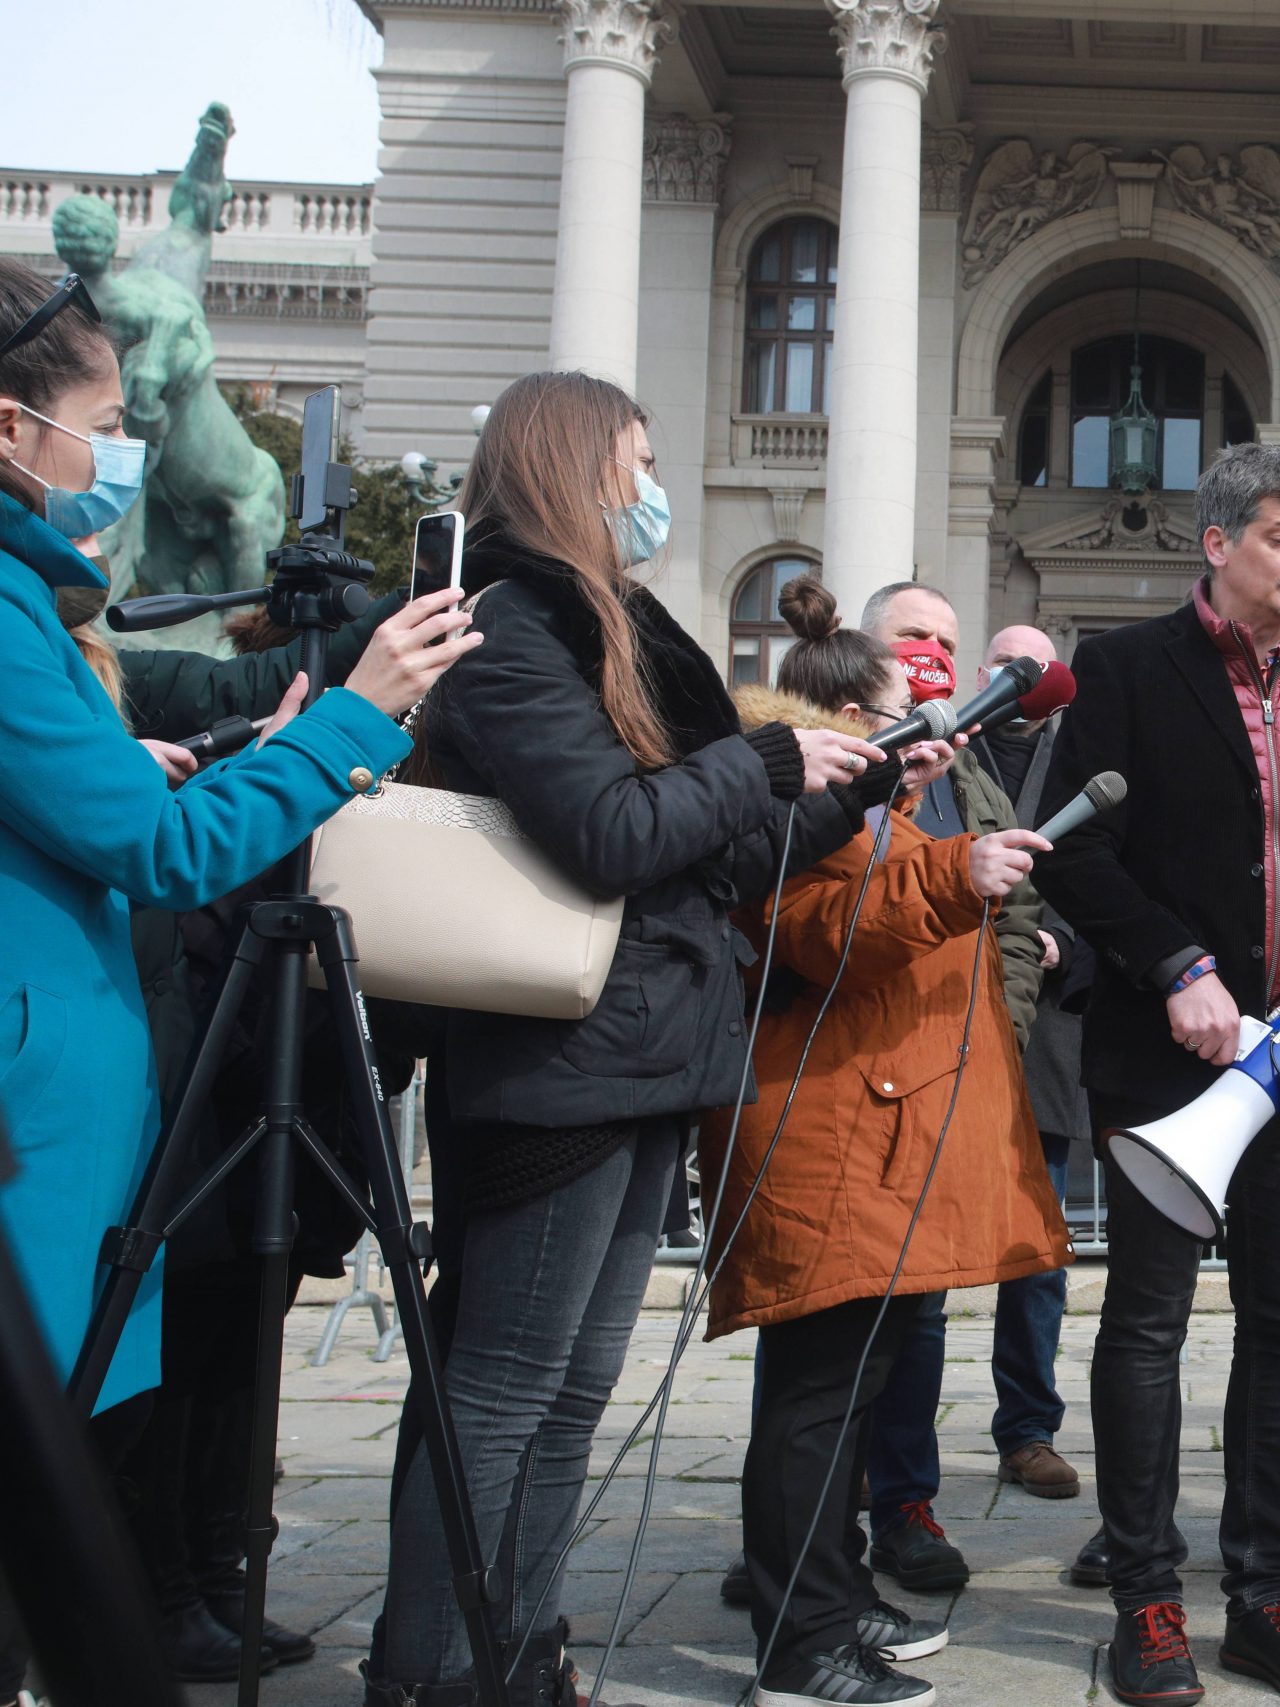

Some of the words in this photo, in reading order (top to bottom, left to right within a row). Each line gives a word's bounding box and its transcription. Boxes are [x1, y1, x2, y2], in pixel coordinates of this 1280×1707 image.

[903, 663, 917, 677] NE
[356, 990, 370, 1040] Velbon
[371, 1066, 384, 1101] EX-640
